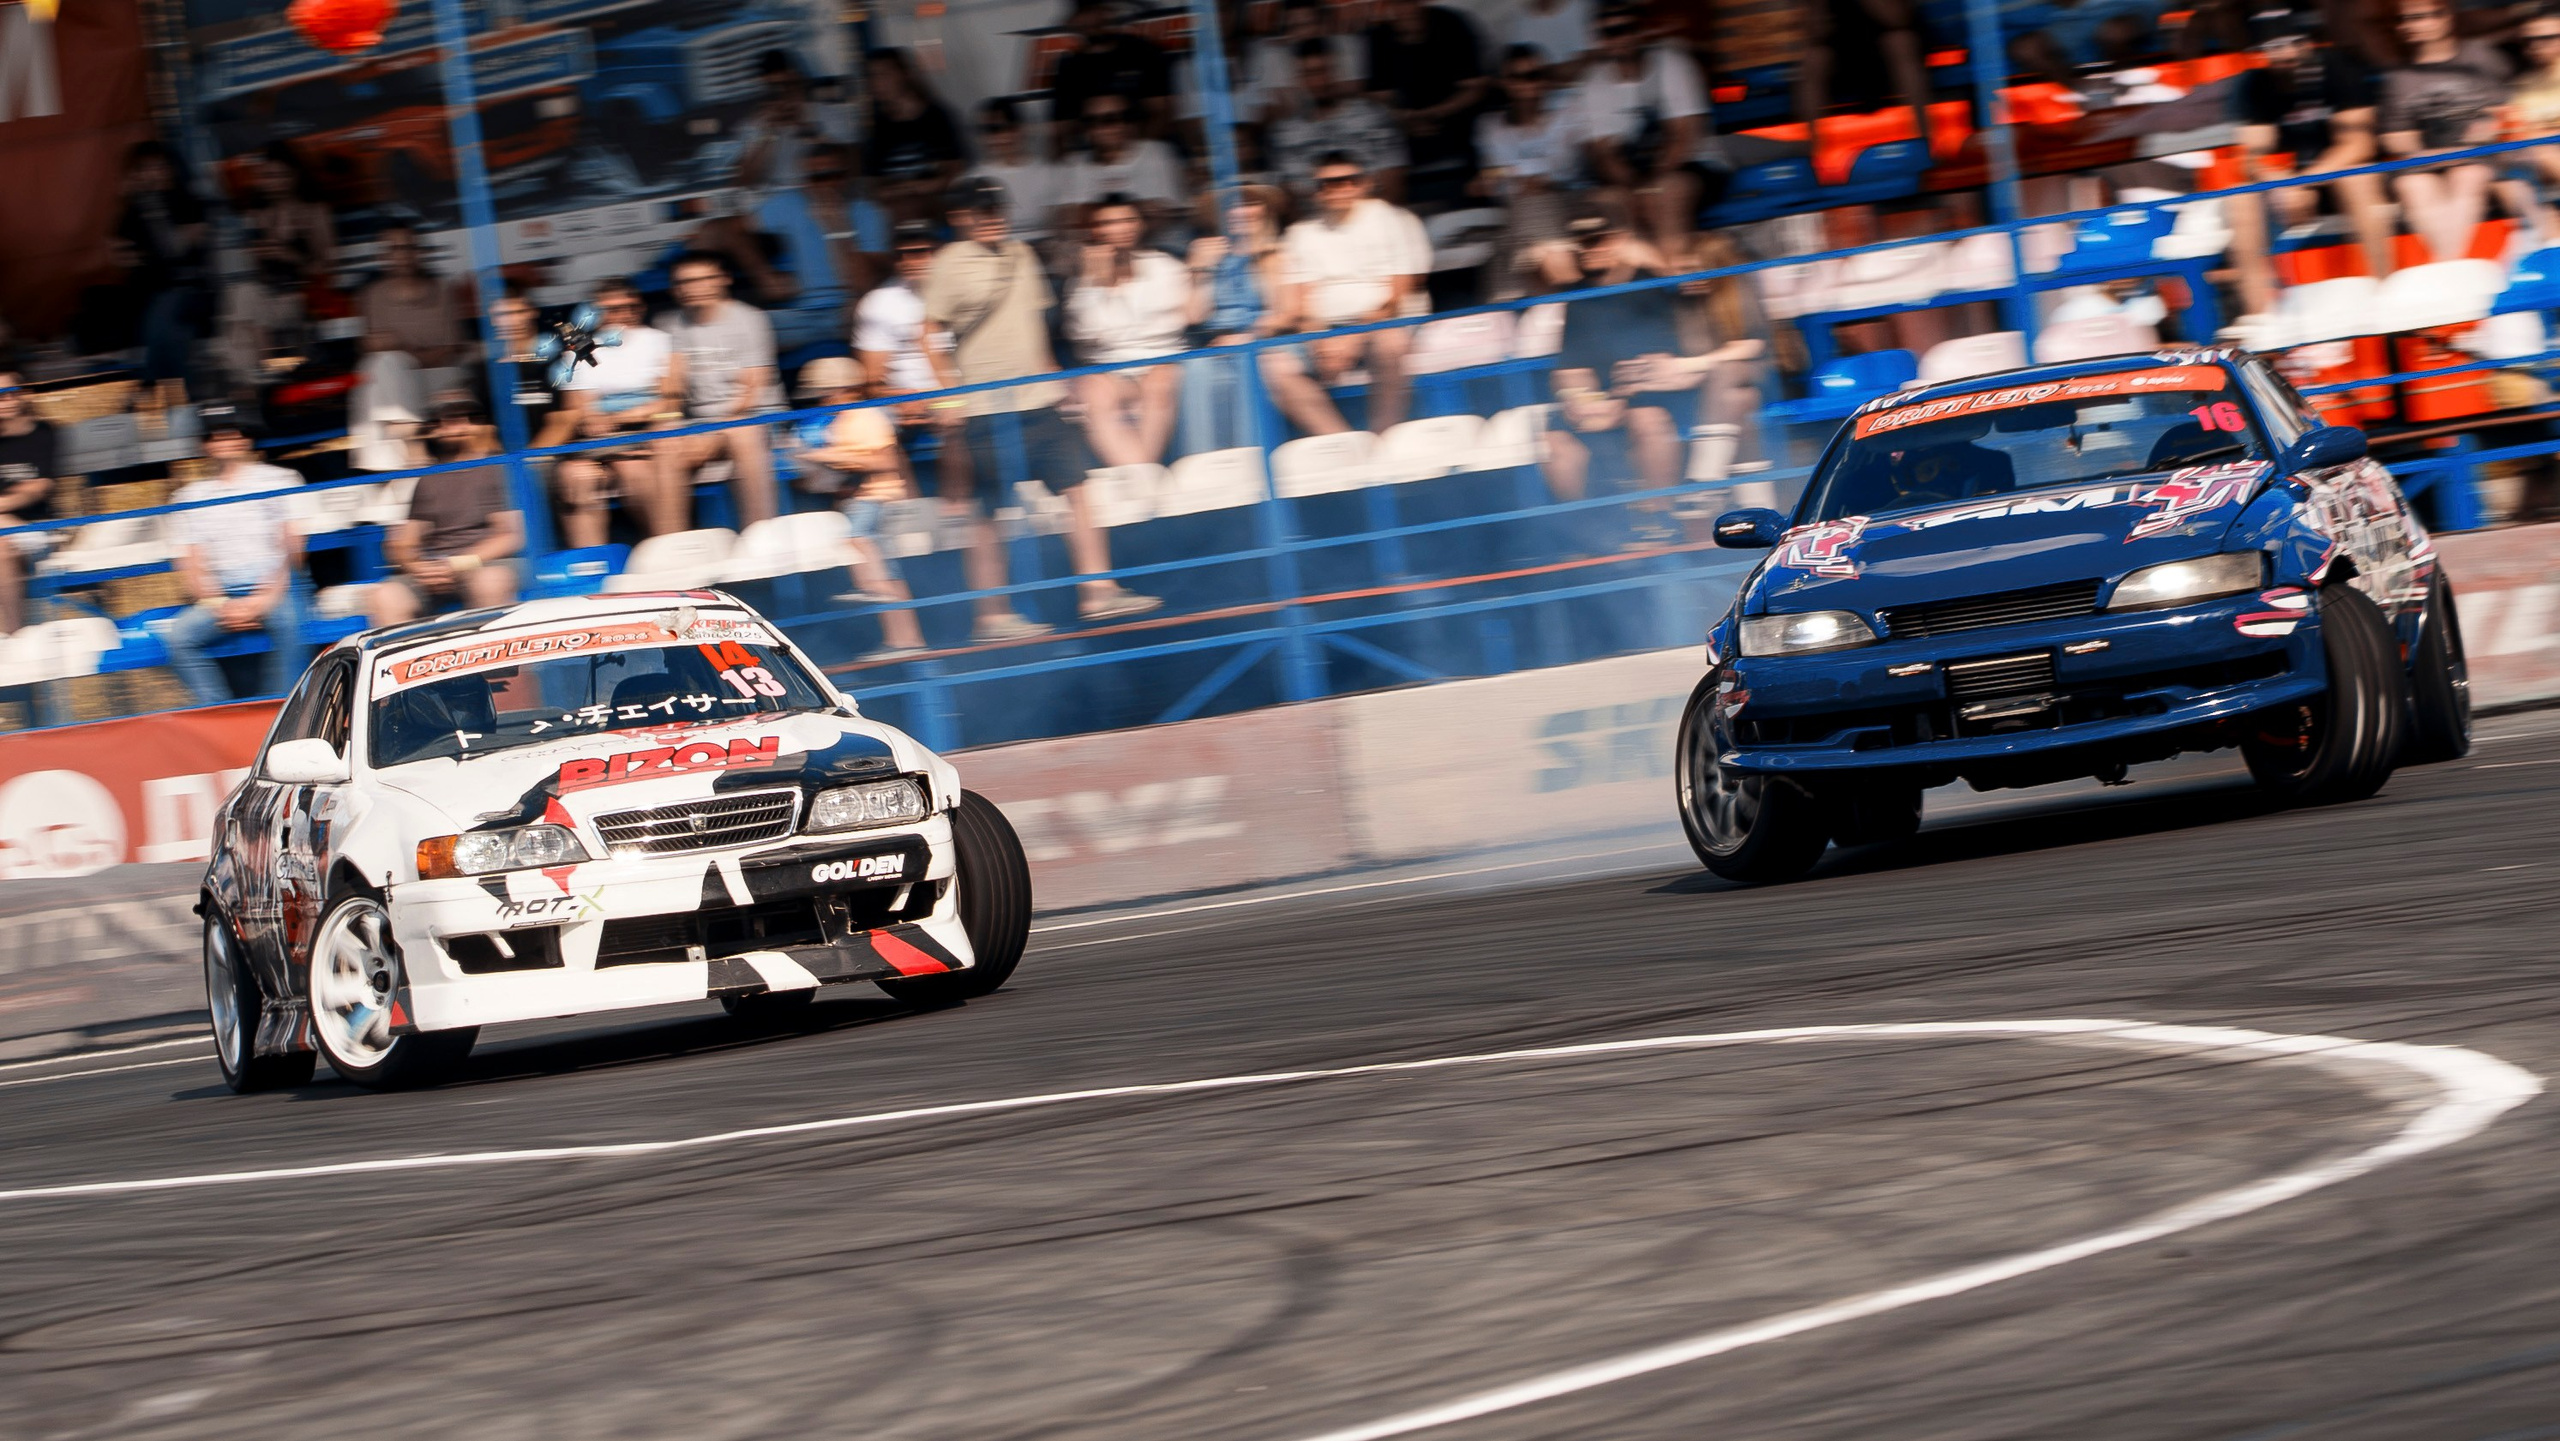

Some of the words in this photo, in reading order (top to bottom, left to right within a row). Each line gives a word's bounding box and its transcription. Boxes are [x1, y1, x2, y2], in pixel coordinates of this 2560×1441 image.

[1867, 396, 1974, 432] DRIFT
[1970, 383, 2061, 410] LETO
[2188, 401, 2247, 432] 16
[407, 644, 505, 678] DRIFT
[508, 632, 591, 657] LETO
[698, 640, 761, 672] 14
[720, 666, 787, 698] 13
[557, 736, 780, 791] BIZON
